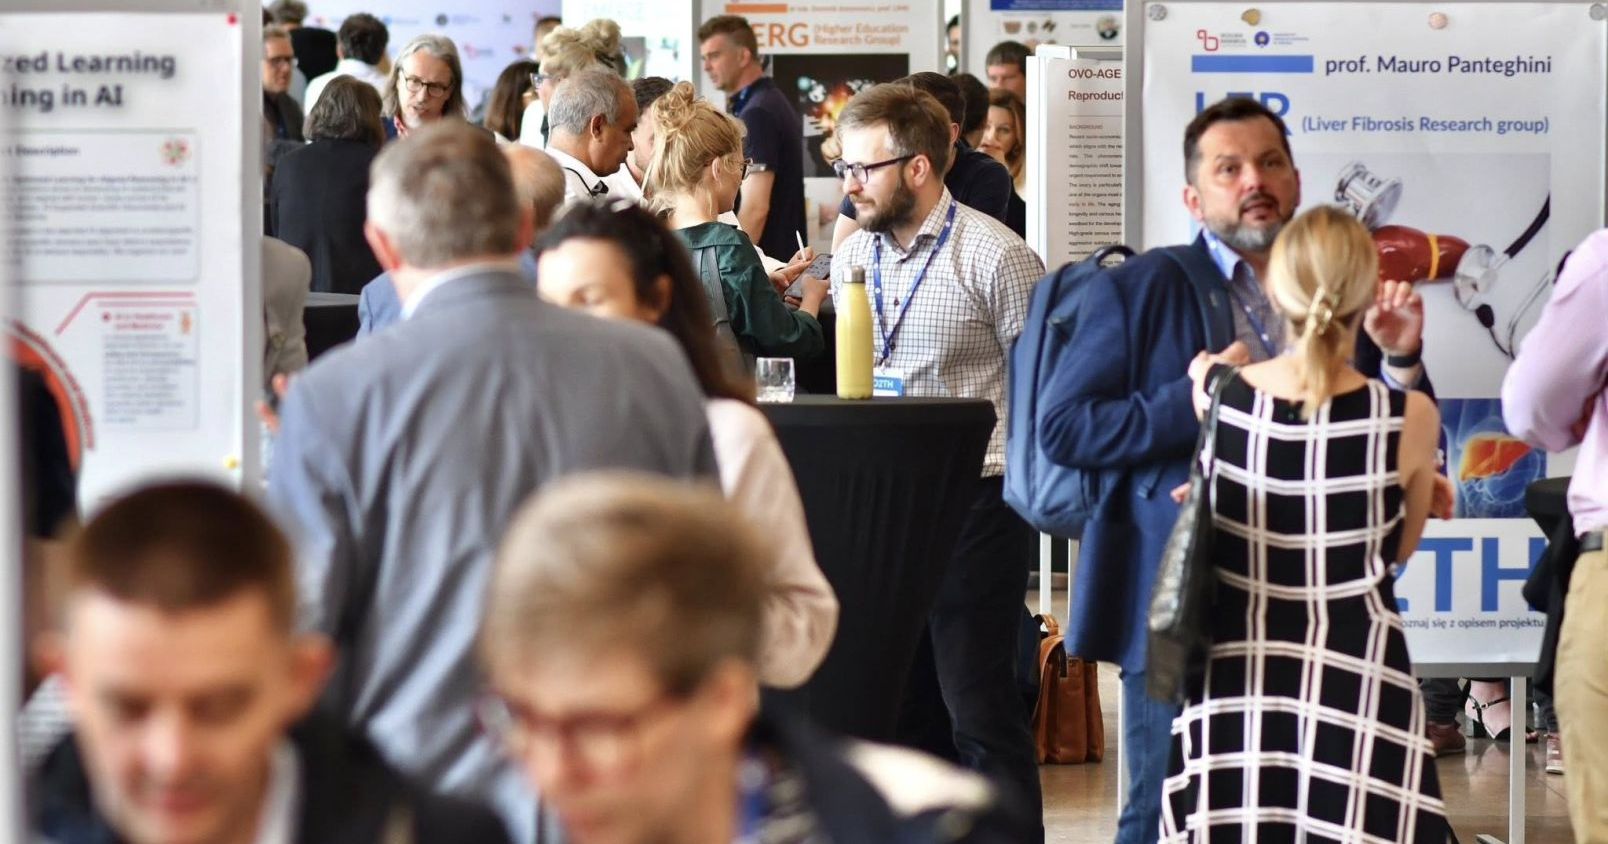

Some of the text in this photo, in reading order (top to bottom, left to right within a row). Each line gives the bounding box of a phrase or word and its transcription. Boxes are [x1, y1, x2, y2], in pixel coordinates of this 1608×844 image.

[751, 23, 809, 48] ERG
[57, 50, 177, 79] Learning
[1068, 68, 1122, 79] OVO-AGE
[1325, 55, 1552, 77] prof. Mauro Panteghini
[62, 84, 88, 106] in
[94, 84, 124, 107] AI
[1302, 116, 1550, 136] (Liver Fibrosis Research group)
[1398, 537, 1547, 613] TH
[1458, 617, 1496, 630] opisem
[1499, 617, 1545, 630] projektu
